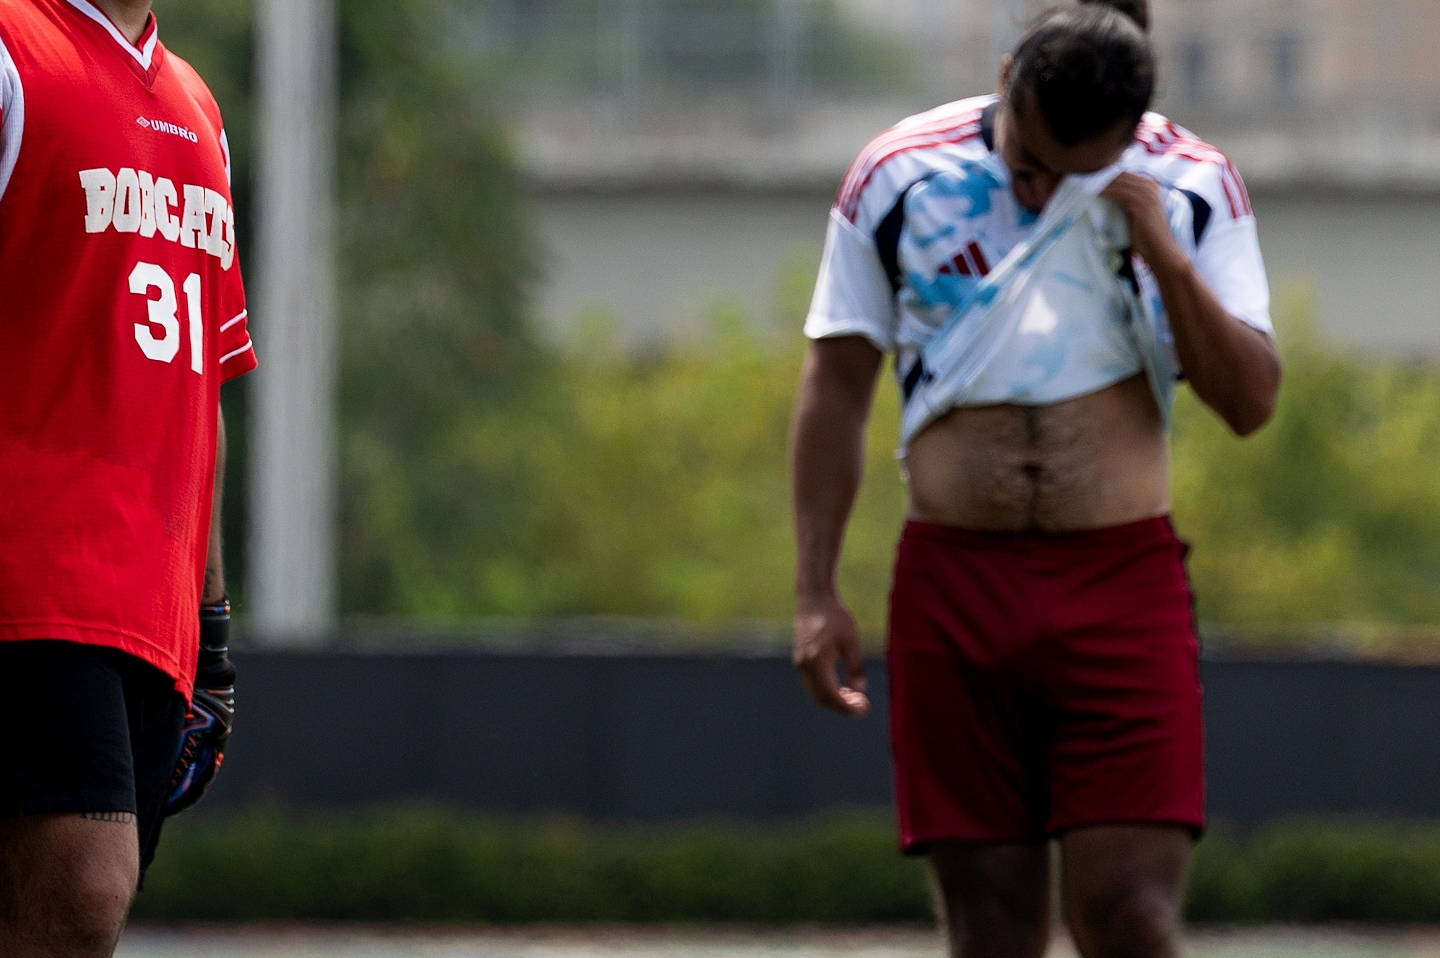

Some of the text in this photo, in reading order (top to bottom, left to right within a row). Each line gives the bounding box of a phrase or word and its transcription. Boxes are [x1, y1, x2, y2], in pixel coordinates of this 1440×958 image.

[150, 119, 198, 143] UMBRO
[78, 167, 235, 272] BOBCATS
[128, 260, 203, 375] 31
